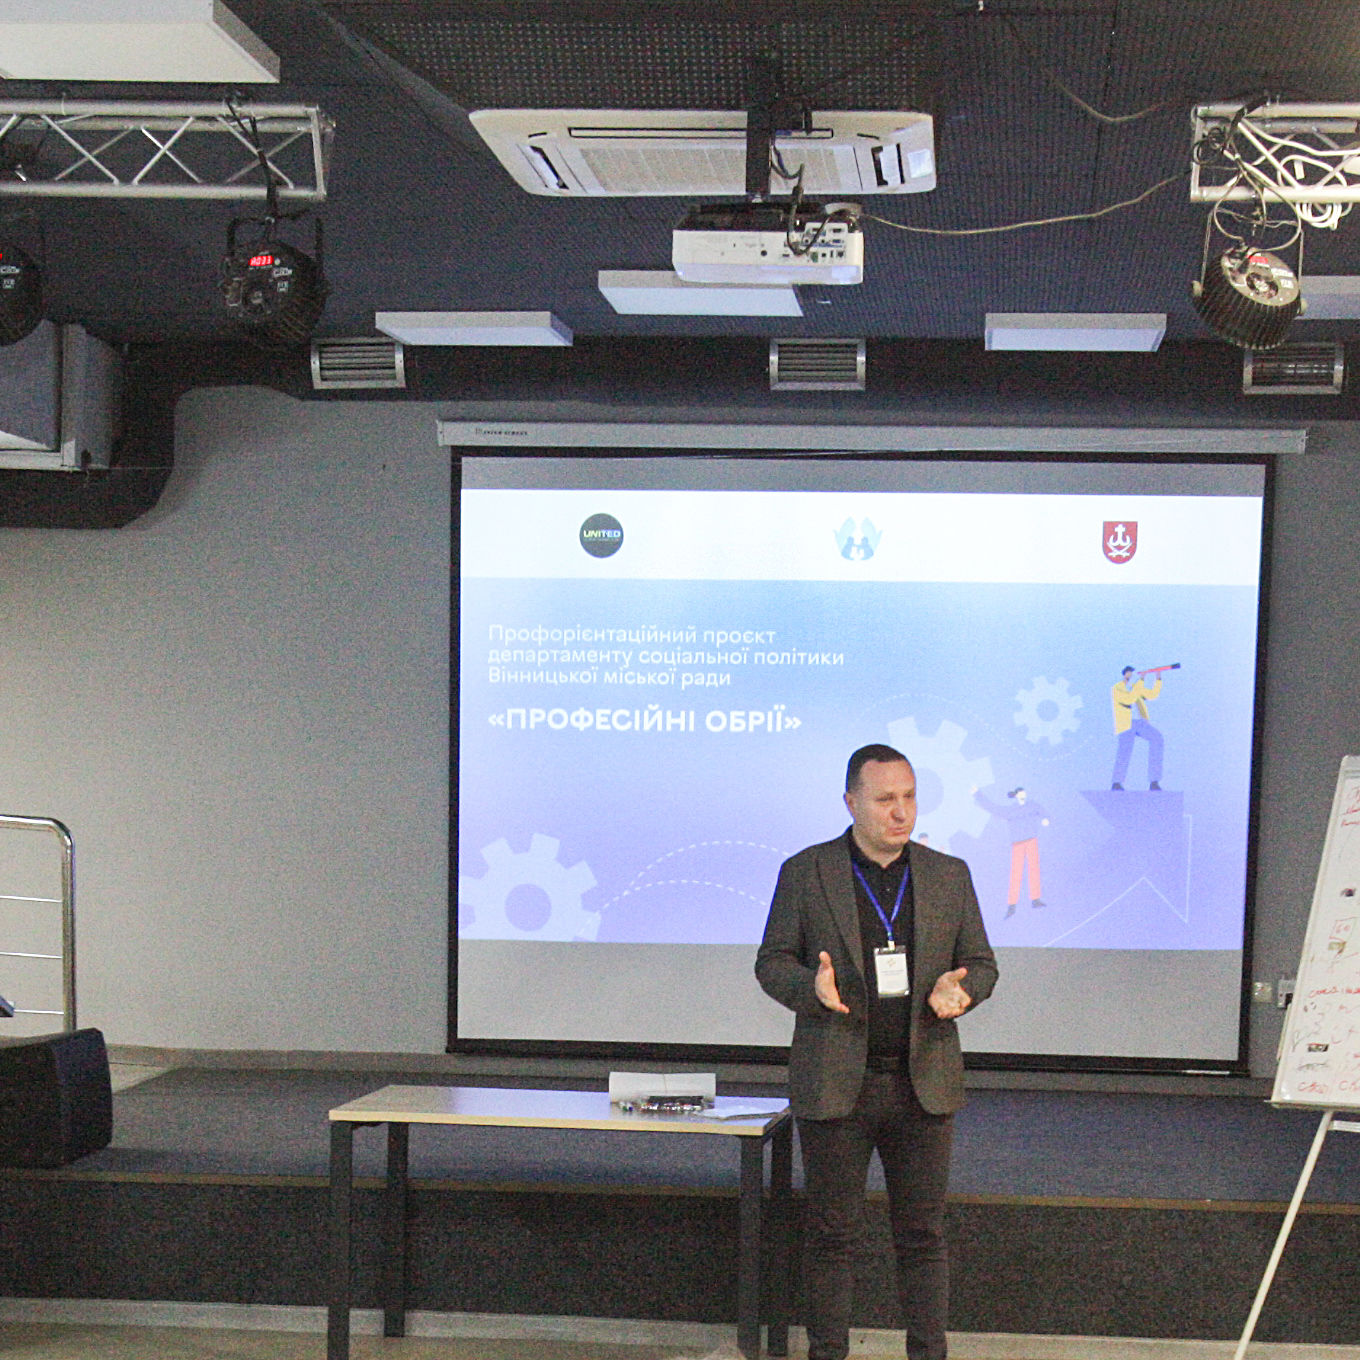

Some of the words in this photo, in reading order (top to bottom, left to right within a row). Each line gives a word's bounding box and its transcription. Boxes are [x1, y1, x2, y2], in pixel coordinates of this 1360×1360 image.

[583, 529, 621, 538] UNITED
[488, 624, 697, 646] Профорієнтаційний
[703, 629, 777, 648] проєкт
[487, 650, 633, 668] департаменту
[638, 647, 748, 666] соціальної
[753, 647, 845, 666] політики
[488, 666, 599, 686] Вінницької
[603, 667, 677, 686] міської
[681, 670, 732, 690] ради
[487, 704, 696, 732] «ПРОФЕСІЙНІ
[705, 704, 803, 733] ОБРІЇ»
